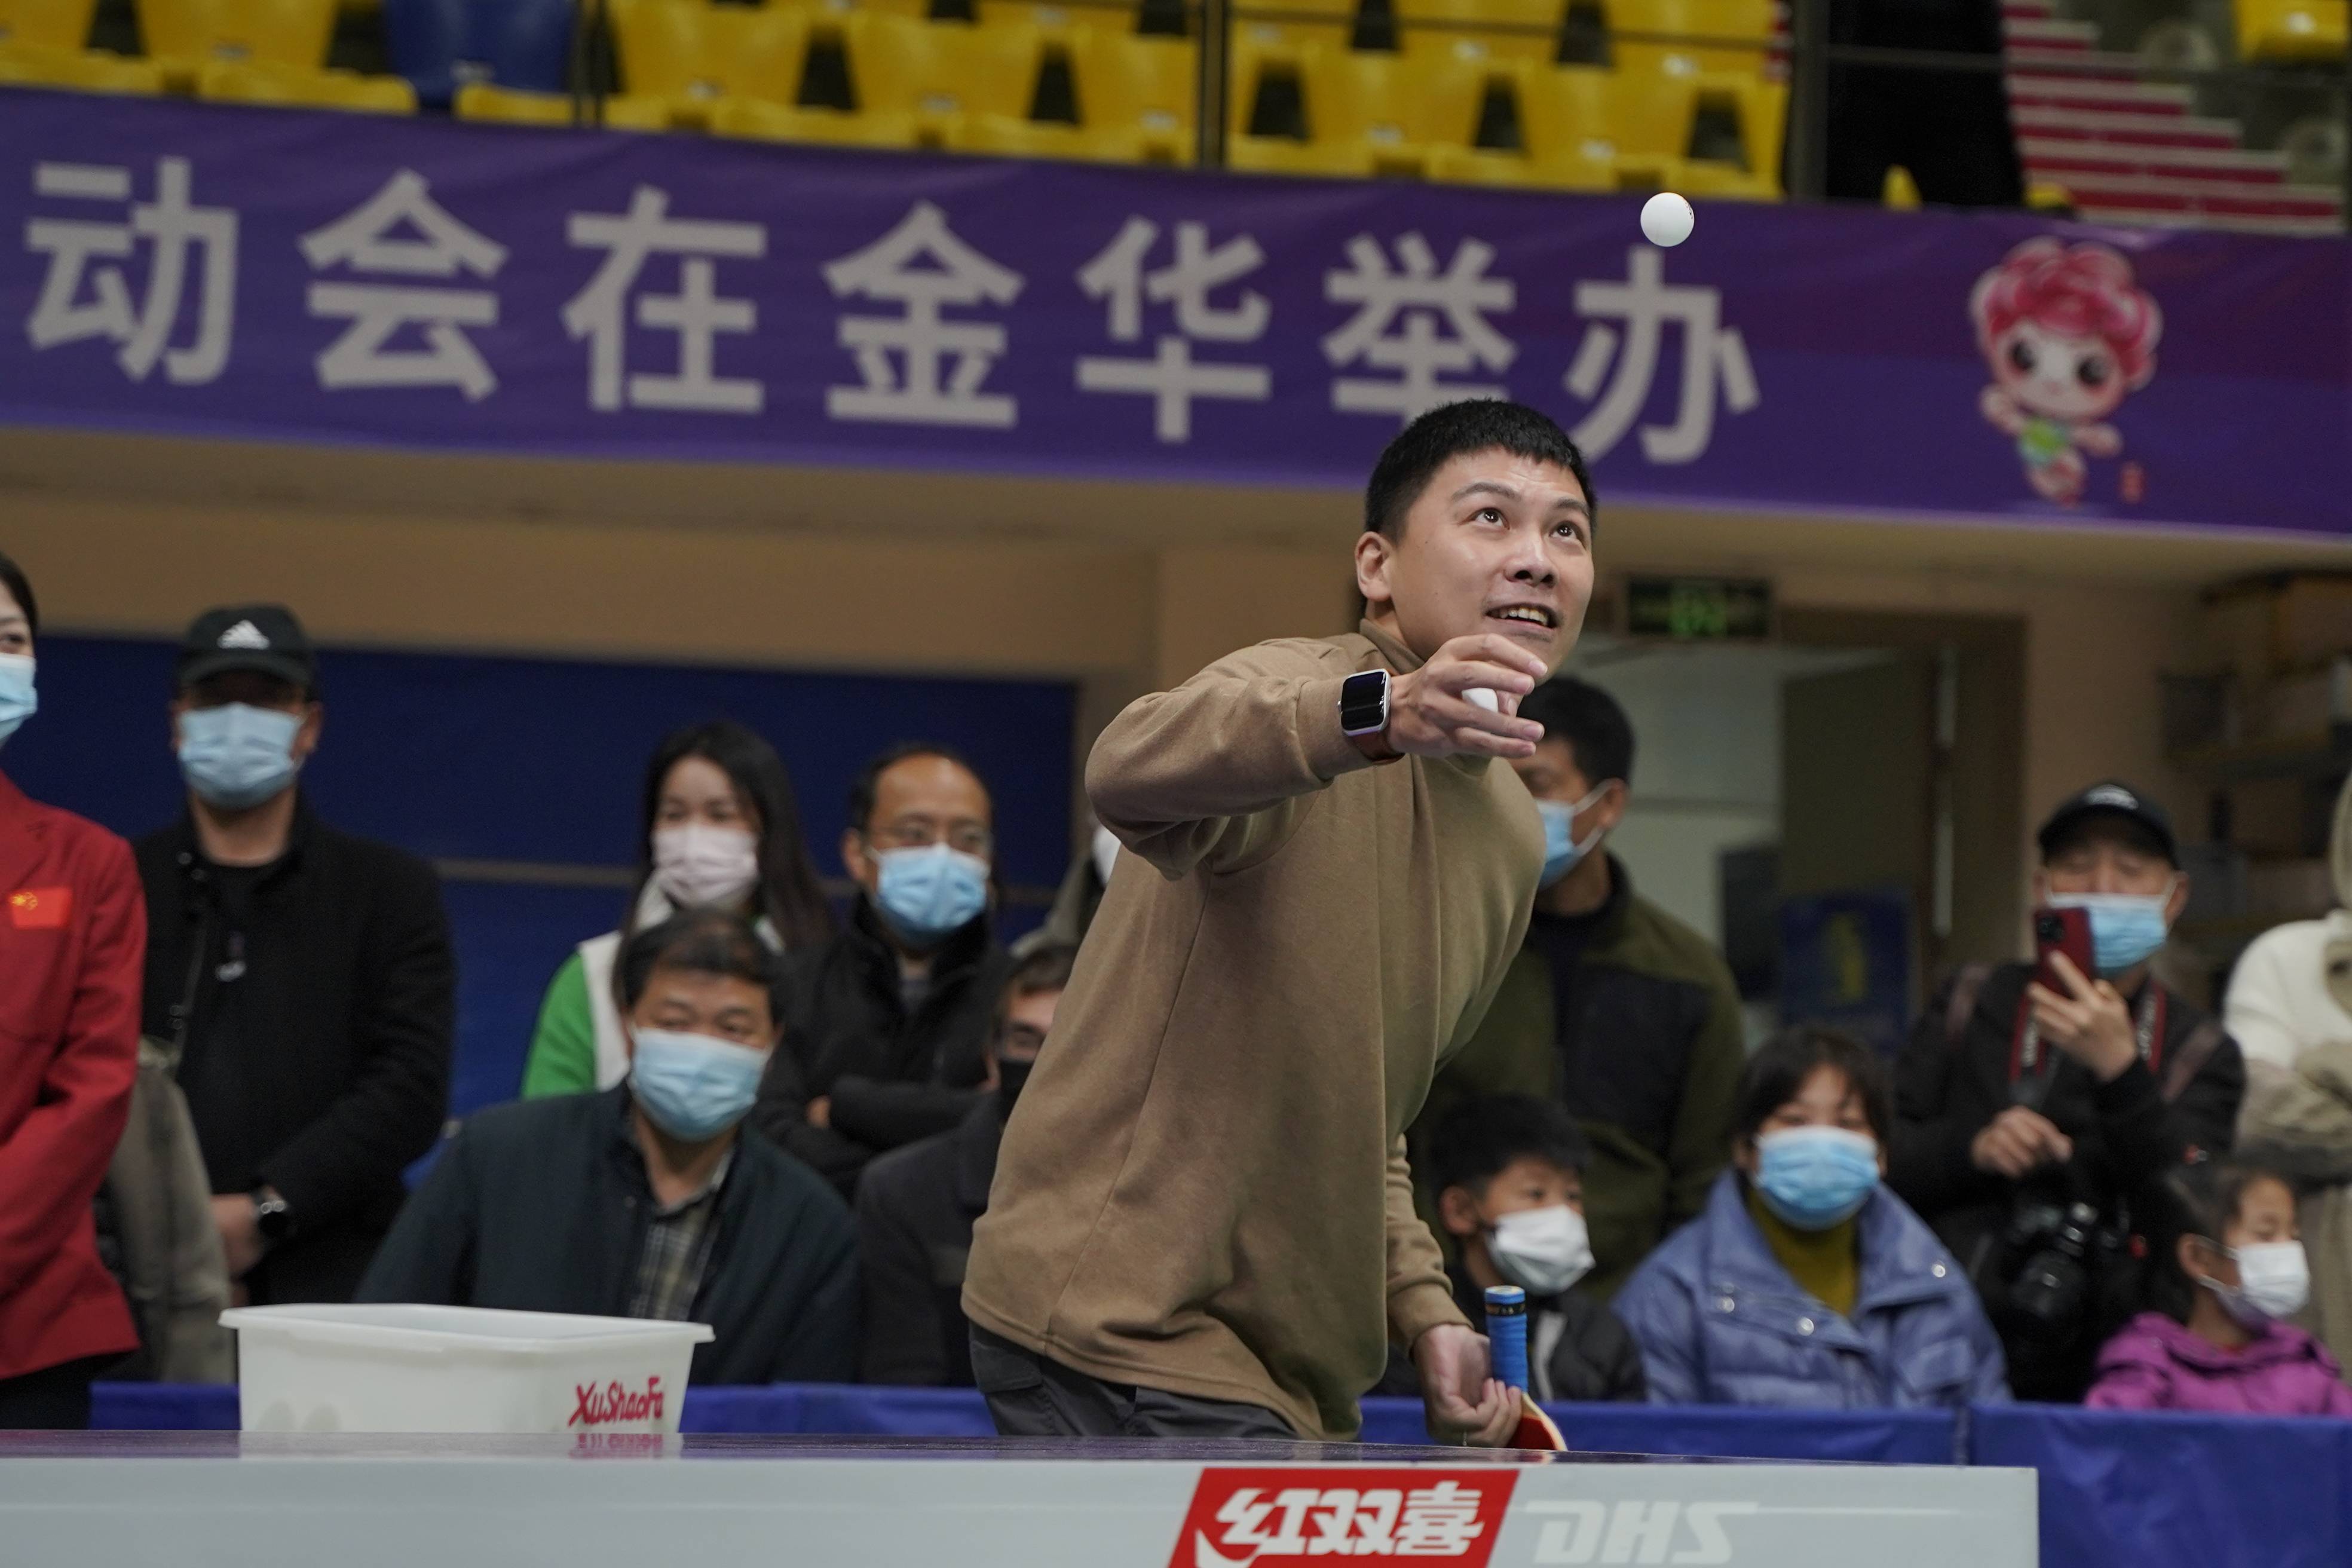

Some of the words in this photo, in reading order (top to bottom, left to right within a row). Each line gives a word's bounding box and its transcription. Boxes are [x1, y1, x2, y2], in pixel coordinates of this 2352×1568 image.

[25, 155, 1760, 464] 动会在金华举办
[1196, 1480, 1485, 1568] 红双喜
[1526, 1499, 1759, 1564] DHS
